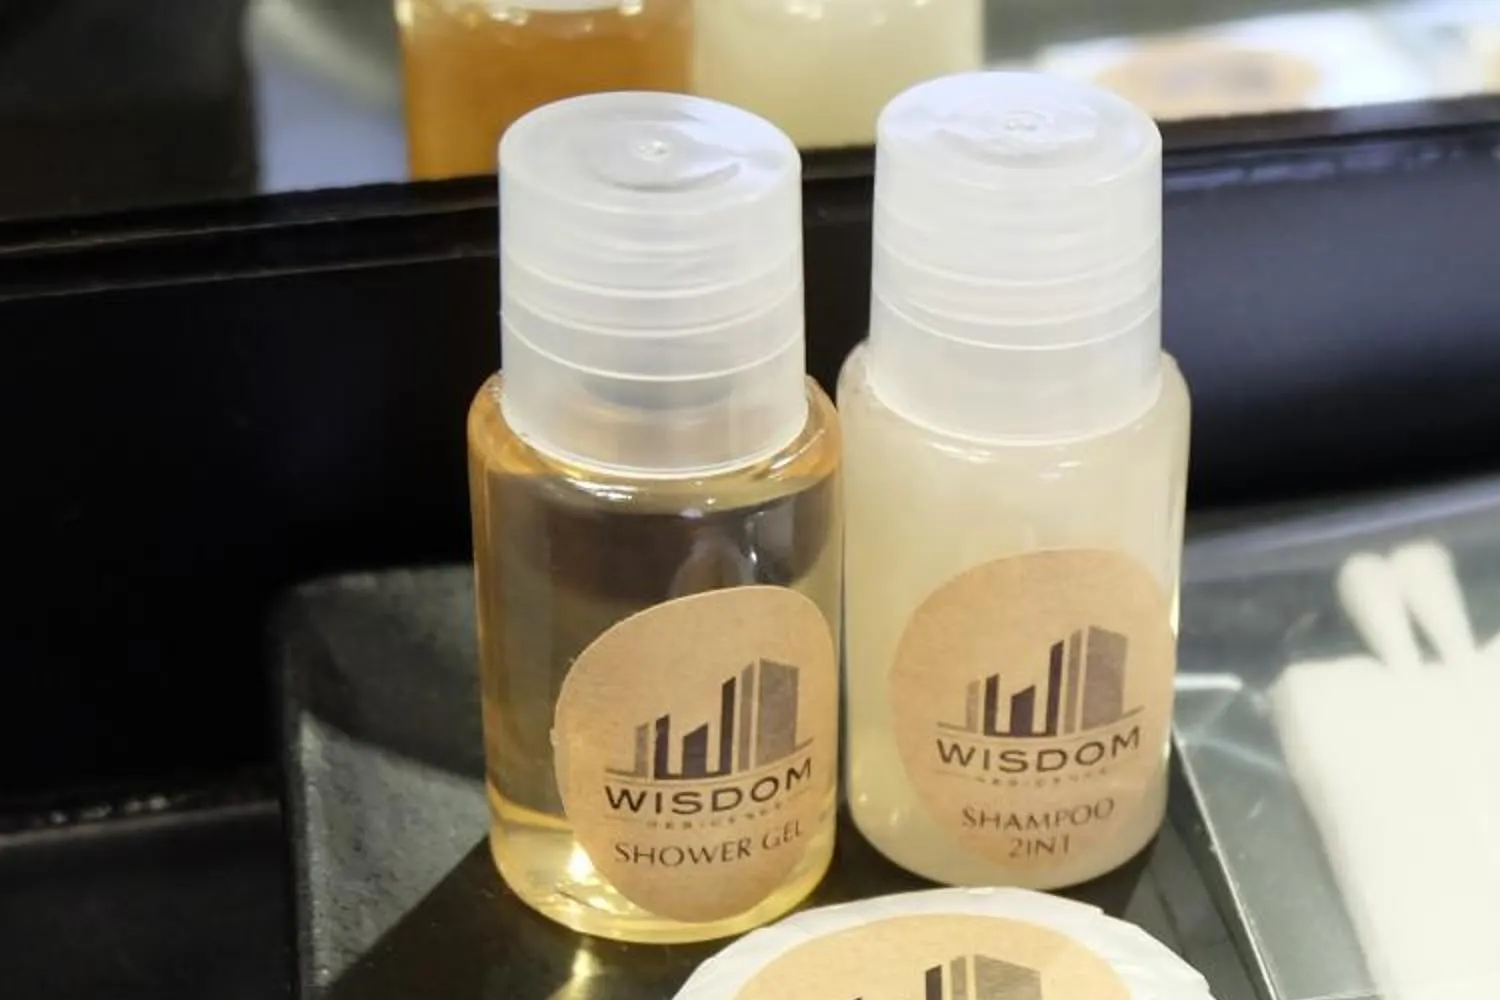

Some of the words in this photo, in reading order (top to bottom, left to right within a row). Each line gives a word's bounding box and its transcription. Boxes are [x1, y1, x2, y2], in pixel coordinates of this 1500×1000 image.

[936, 726, 1140, 774] WISDOM
[604, 757, 812, 815] WISDOM
[961, 797, 1115, 831] SHAMPOO
[614, 837, 752, 867] SHOWER
[761, 819, 803, 850] GEL
